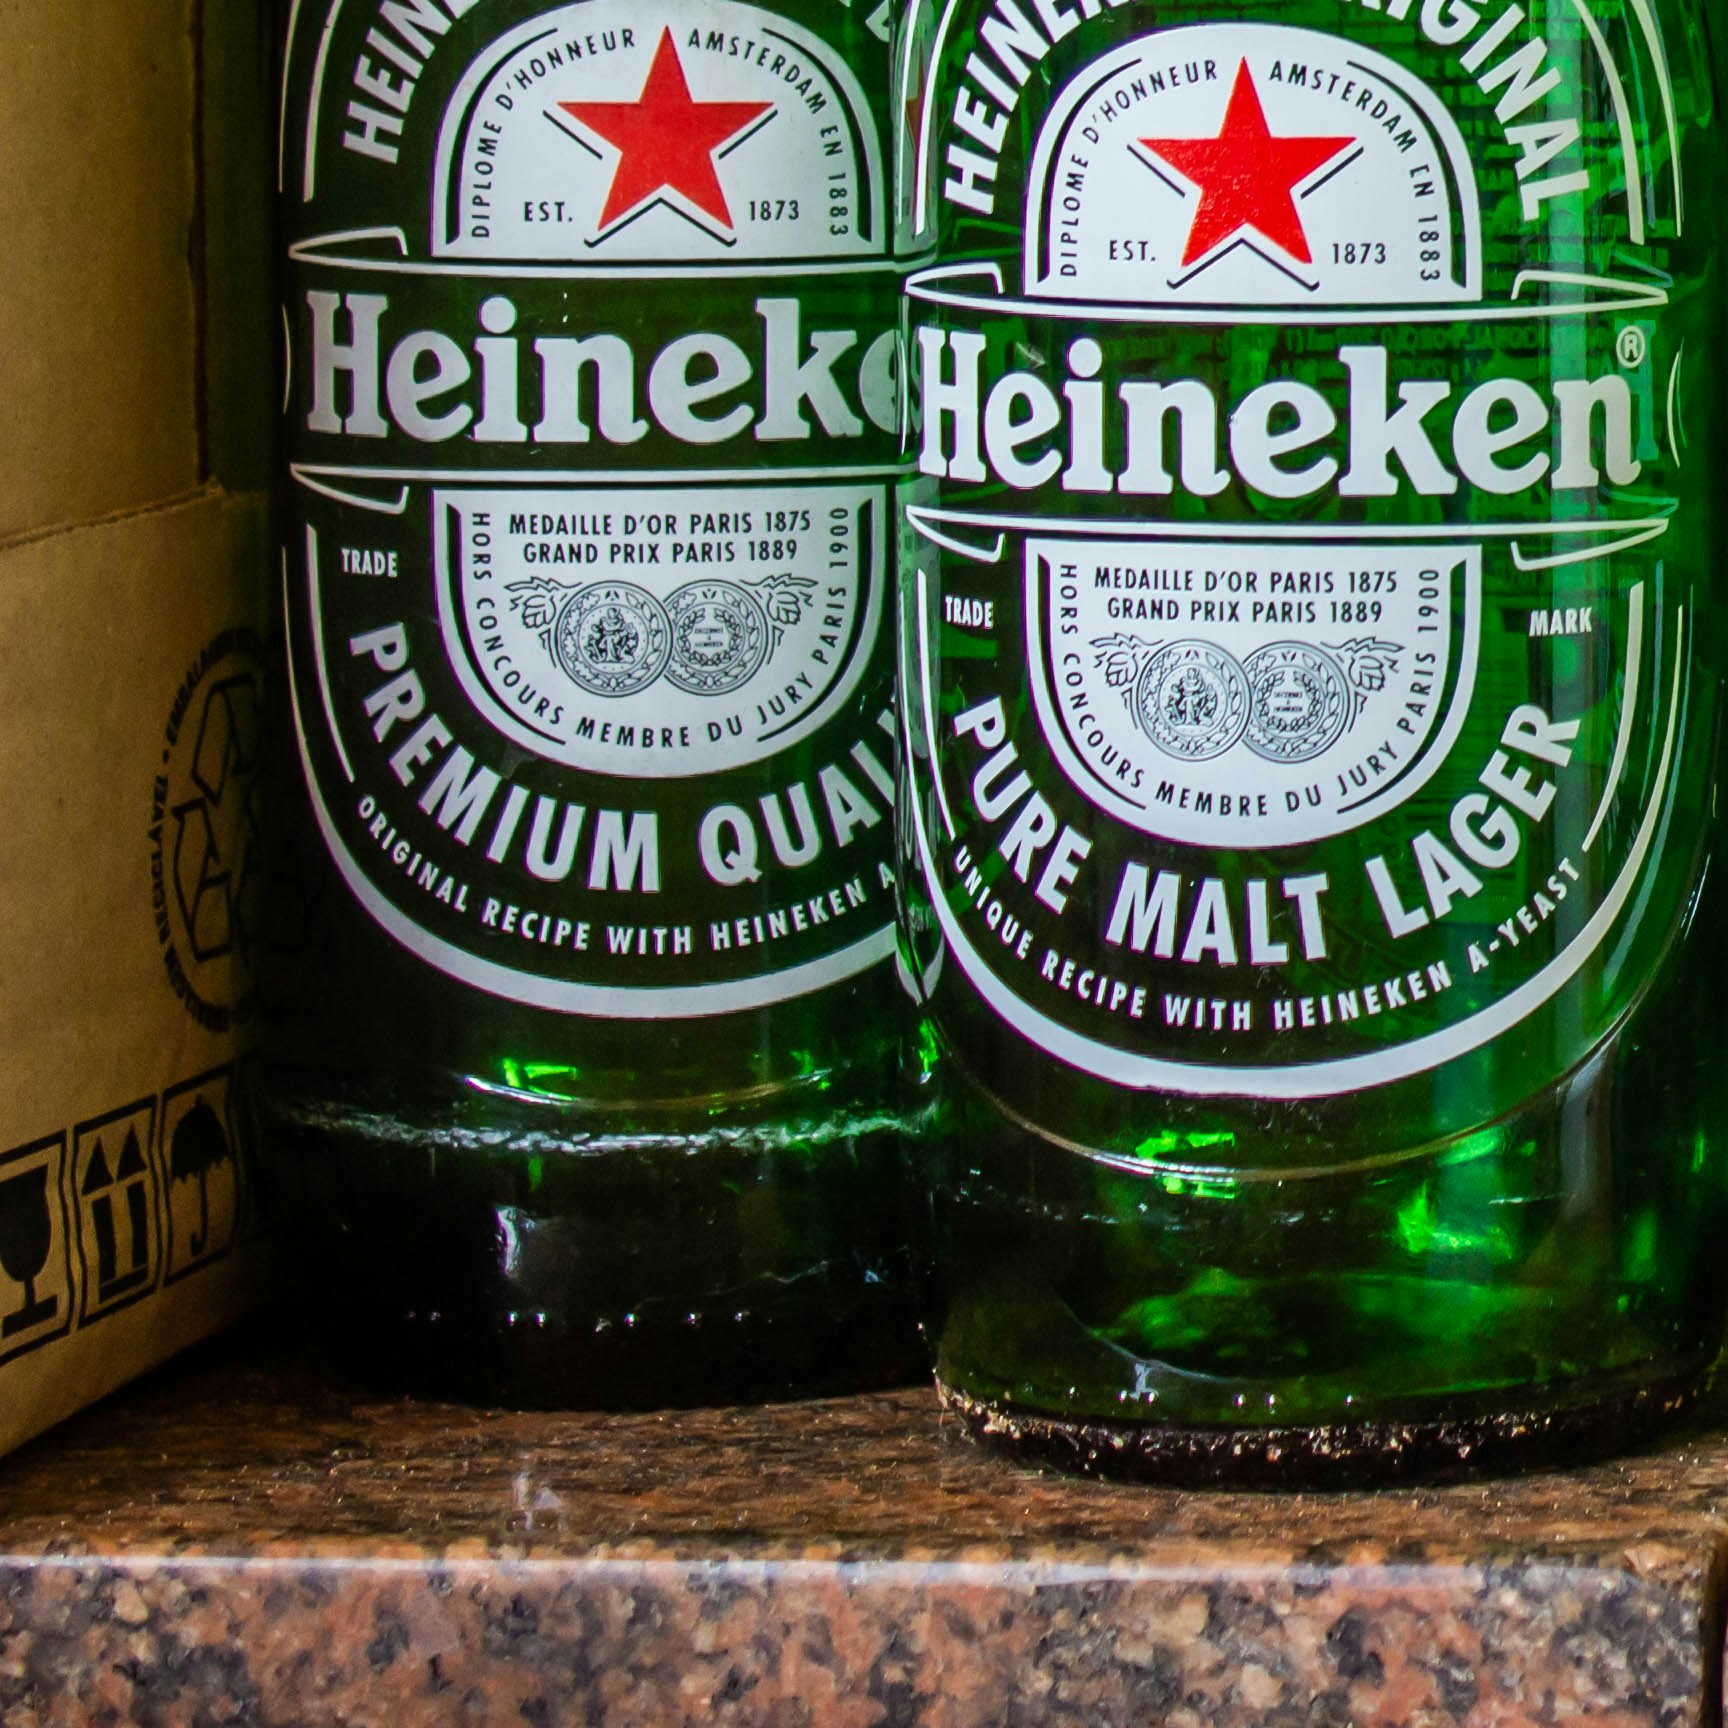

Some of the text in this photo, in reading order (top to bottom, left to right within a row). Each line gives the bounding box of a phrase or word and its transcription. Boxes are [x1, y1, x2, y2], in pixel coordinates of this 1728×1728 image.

[472, 29, 848, 237] DIPLOME D'HONNEUR AMSTERDAM EN 1883
[1062, 155, 1088, 276] DIPLOME
[1082, 60, 1216, 142] D'HONNEUR
[1270, 61, 1417, 152] AMSTERDAM
[1418, 215, 1440, 280] 1883
[524, 200, 799, 223] EST. 1873
[1110, 240, 1385, 264] EST. 1873
[918, 328, 1642, 498] Heineken
[342, 548, 397, 577] TRADE
[510, 511, 810, 535] MEDAILLE D'OR PARIS 1875
[524, 541, 797, 563] GRAND PRIX PARIS 1889
[945, 596, 993, 629] TRADE
[1095, 567, 1396, 593] MEDAILLE D'OR PARIS 1875
[1108, 597, 1381, 623] GRAND PRIX PARIS 1889
[1529, 608, 1592, 636] MARK
[472, 508, 848, 748] HORS CONCOURS MEMBRE DU JURY PARIS 1900
[1061, 565, 1439, 816] HORS CONCOURS MEMBRE DU JURY PARIS 1900
[350, 621, 659, 893] PREMIUM
[359, 797, 467, 912] ORIGINAL
[482, 899, 589, 950] RECIPE
[607, 927, 690, 954] WITH
[711, 885, 865, 950] HEINEKEN
[954, 697, 1580, 966] PURE MALT LAGER
[954, 846, 1579, 1030] UNIQUE RECIPE WITH HEINEKEN A-YEAST
